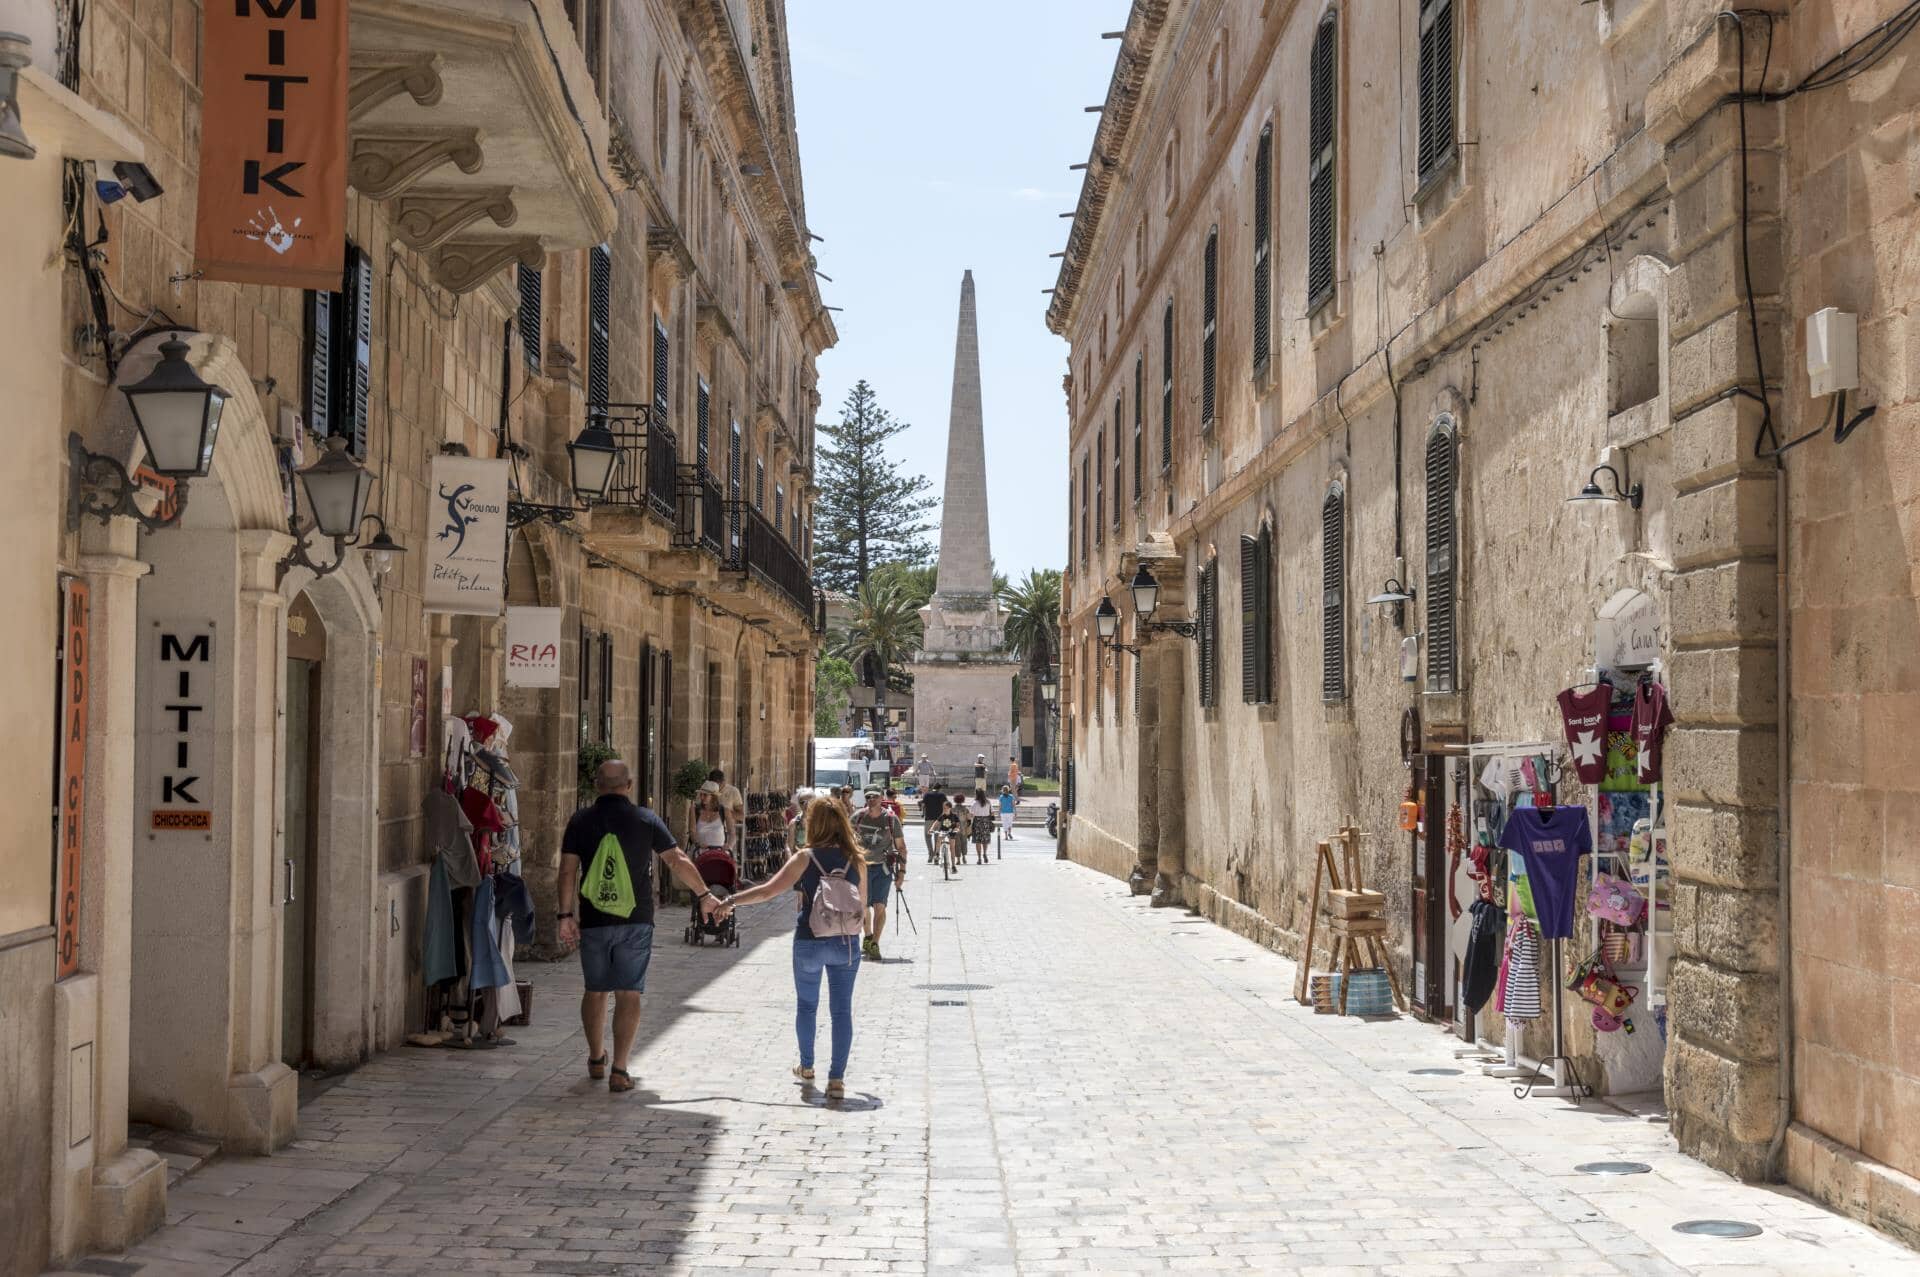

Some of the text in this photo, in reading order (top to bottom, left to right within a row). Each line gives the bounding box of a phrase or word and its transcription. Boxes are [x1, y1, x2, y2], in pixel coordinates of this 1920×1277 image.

[510, 643, 557, 662] RIA
[161, 634, 209, 804] MITIK
[1568, 717, 1582, 726] Sant
[63, 592, 84, 966] MODA CHICO
[154, 814, 208, 827] CHICO-CHICA
[598, 891, 618, 902] 360
